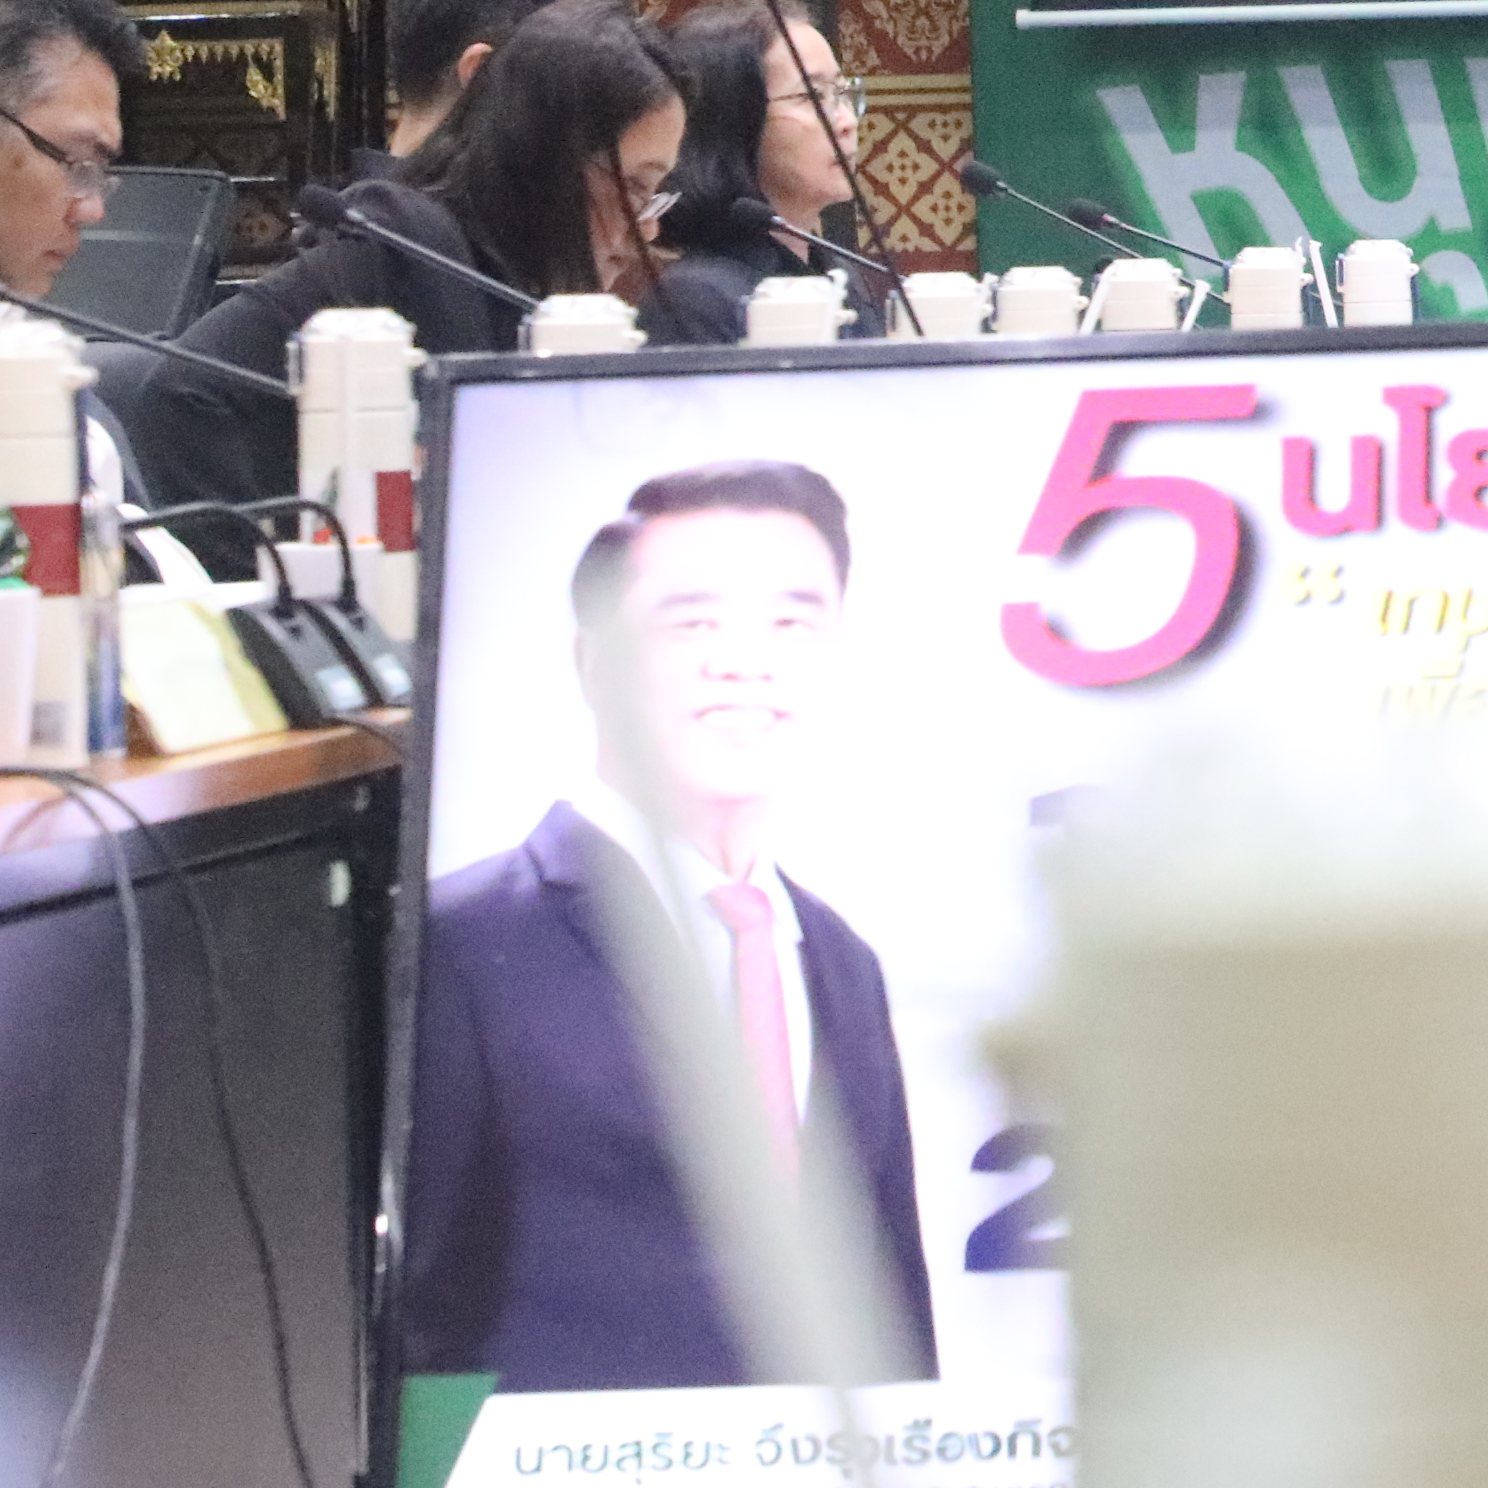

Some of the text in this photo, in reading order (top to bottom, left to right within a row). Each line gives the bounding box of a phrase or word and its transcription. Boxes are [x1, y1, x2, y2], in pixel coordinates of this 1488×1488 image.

[1000, 382, 1258, 687] 5
[964, 1123, 1074, 1272] 2
[515, 1417, 1074, 1485] นายสุริยะ จึงรุงเรืองกิจ
